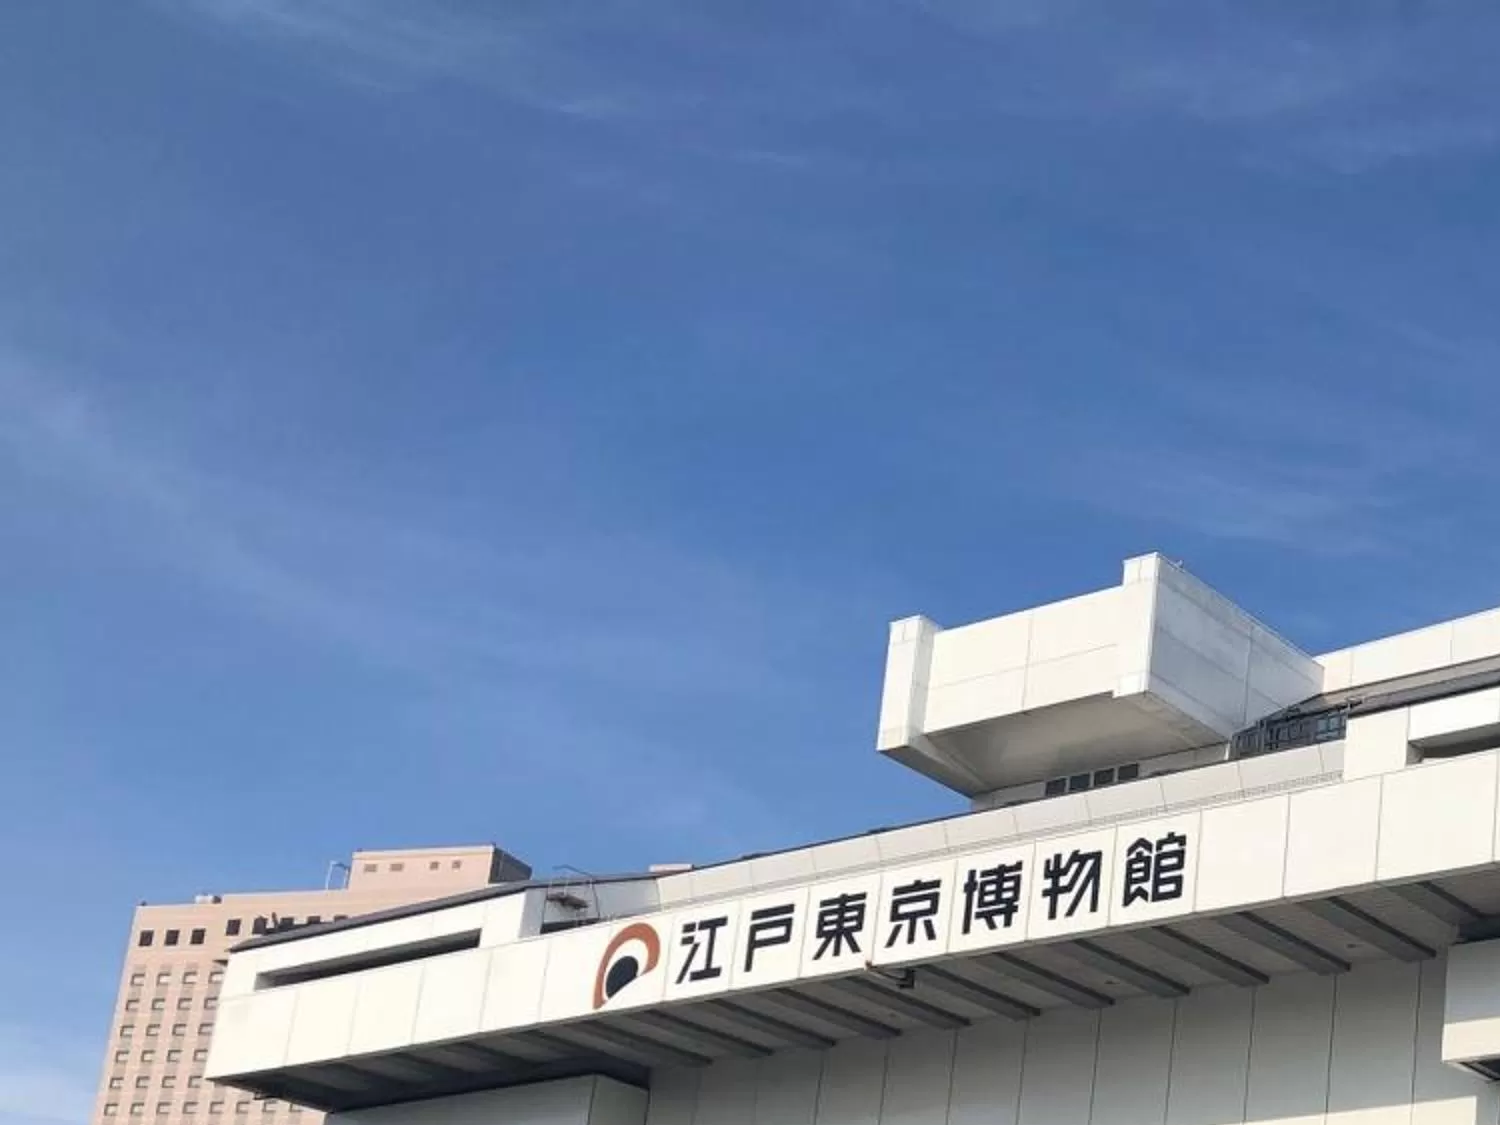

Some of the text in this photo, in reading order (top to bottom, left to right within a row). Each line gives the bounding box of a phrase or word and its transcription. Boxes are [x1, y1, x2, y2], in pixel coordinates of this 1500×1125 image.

[676, 832, 1188, 985] 江戸東京博物館
